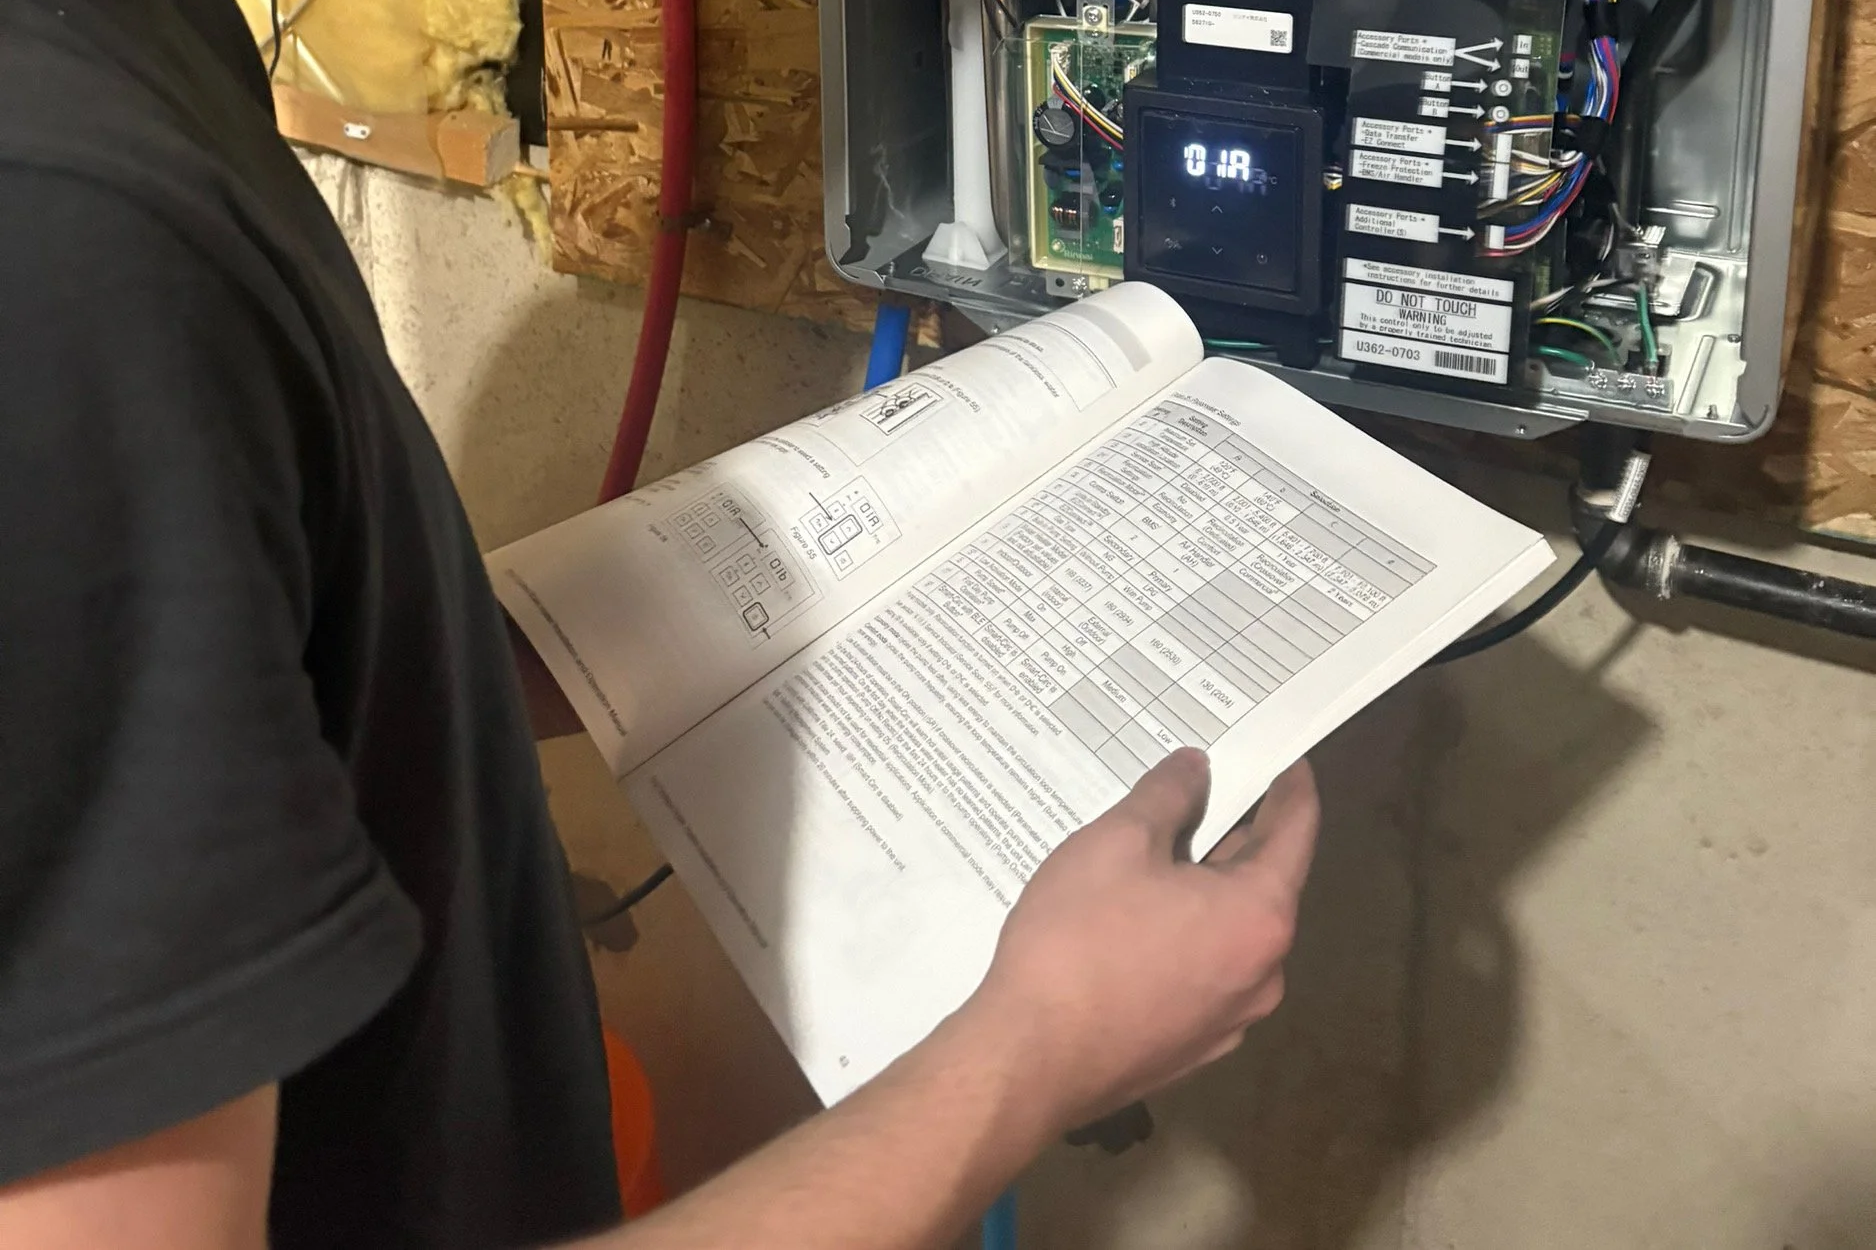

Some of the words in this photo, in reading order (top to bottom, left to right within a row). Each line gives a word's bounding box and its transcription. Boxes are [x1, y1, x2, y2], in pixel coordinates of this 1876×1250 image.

[1357, 33, 1394, 42] Accessory
[1519, 41, 1529, 49] In
[1425, 73, 1450, 82] Button
[1515, 65, 1528, 73] Out
[1423, 99, 1449, 107] Button
[1361, 121, 1399, 133] Accessory
[1402, 125, 1424, 135] Ports
[1386, 132, 1418, 141] Transfer
[1377, 138, 1406, 148] Connect
[1359, 152, 1397, 164] Accessory
[1400, 157, 1421, 166] Ports
[1391, 164, 1433, 176] Protection
[1394, 173, 1424, 183] Handler
[1355, 207, 1393, 219] Accessory
[1396, 212, 1418, 222] Ports
[1355, 215, 1395, 227] Additional
[1367, 272, 1416, 285] instructions
[1420, 279, 1431, 288] for
[1436, 281, 1465, 293] further
[1469, 286, 1500, 297] details
[1383, 266, 1420, 278] accessory
[1425, 271, 1475, 285] installation
[1376, 289, 1393, 303] DO
[1400, 293, 1426, 308] NOT
[1435, 298, 1477, 316] TOUCH
[1360, 312, 1377, 321] This
[1380, 316, 1409, 326] control
[1412, 321, 1430, 331] only
[1445, 326, 1455, 334] be
[1458, 329, 1493, 340] adjusted
[1399, 309, 1447, 325] WARNING
[1359, 321, 1368, 329] by
[1379, 325, 1413, 337] properly
[1416, 331, 1446, 342] trained
[1356, 340, 1421, 361] U362-0703
[1208, 518, 1246, 546] Recirculation
[788, 525, 810, 551] Figure
[805, 549, 817, 560] 55
[1101, 536, 1135, 562] Secondary
[1102, 551, 1115, 561] NG
[1180, 553, 1199, 567] (AH)
[1188, 547, 1215, 567] Handler
[1094, 564, 1115, 580] Pump
[1256, 553, 1296, 582] Recirculation
[1142, 584, 1157, 596] LPG
[1147, 571, 1173, 592] Primary
[1036, 602, 1047, 612] On
[1122, 586, 1137, 597] With
[1133, 595, 1153, 612] Pump
[1002, 618, 1021, 634] Pump
[980, 636, 1004, 658] disabled
[983, 624, 1013, 651] Smart-Circ
[1075, 636, 1087, 646] Off
[1060, 644, 1077, 659] High
[1020, 658, 1052, 687] Smart-Circ
[1040, 652, 1059, 669] Pump
[1055, 665, 1067, 675] On
[1018, 671, 1043, 693] enabled
[1102, 680, 1127, 702] Medium
[1156, 729, 1173, 744] Low
[1026, 788, 1047, 808] higher
[1043, 805, 1058, 819] (but
[1055, 817, 1069, 831] also
[1037, 779, 1053, 793] loop
[1049, 791, 1084, 826] temperature
[992, 787, 1015, 811] selected
[1011, 809, 1043, 843] (Parameter
[865, 824, 883, 843] power
[978, 796, 992, 808] and
[987, 807, 1011, 830] operate
[1005, 828, 1025, 847] pump
[1022, 844, 1042, 864] based
[991, 843, 1012, 864] (Pump
[1000, 837, 1013, 848] the
[1010, 847, 1023, 860] unit
[1020, 859, 1033, 872] can
[941, 825, 971, 858] commercial
[968, 857, 985, 875] mode
[981, 875, 997, 890] may
[994, 888, 1012, 907] result
